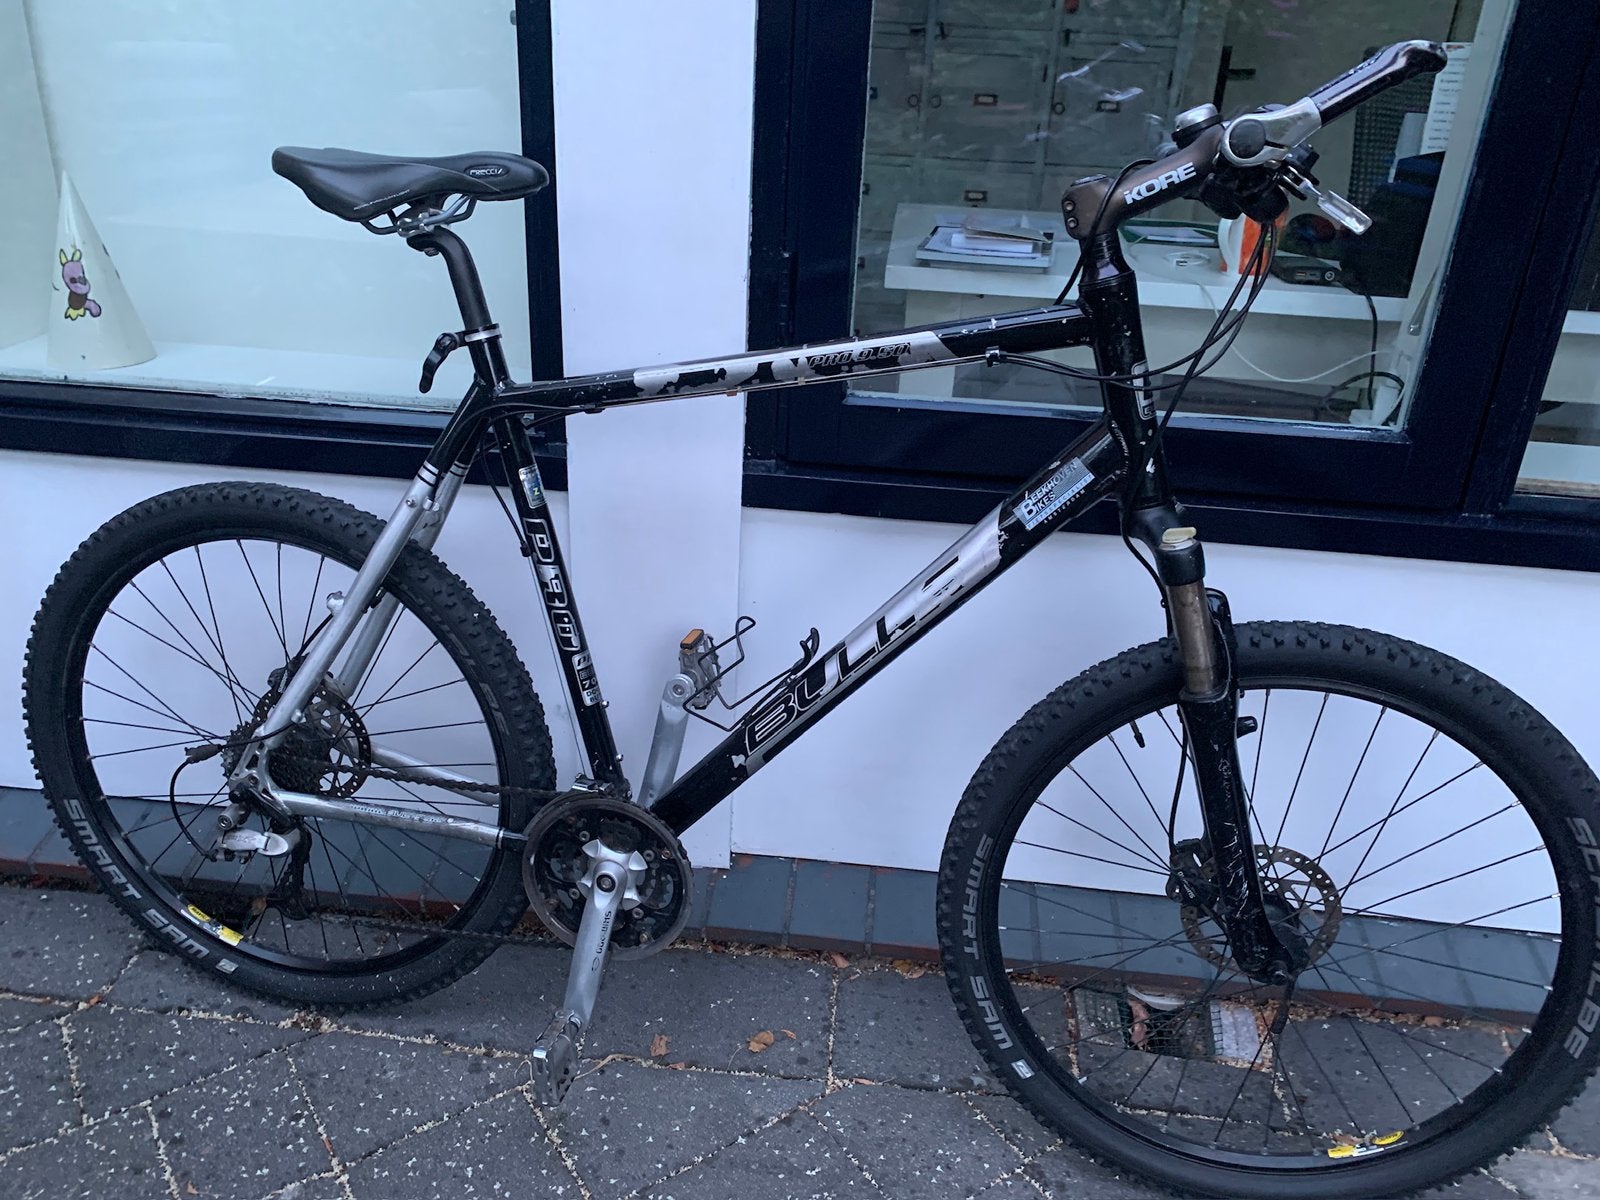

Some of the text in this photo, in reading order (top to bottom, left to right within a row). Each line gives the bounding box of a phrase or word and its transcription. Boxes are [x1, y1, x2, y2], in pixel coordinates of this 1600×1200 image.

[1123, 161, 1197, 205] KORE
[63, 799, 210, 959] SMART SAM
[962, 833, 1014, 1051] SMART SAM
